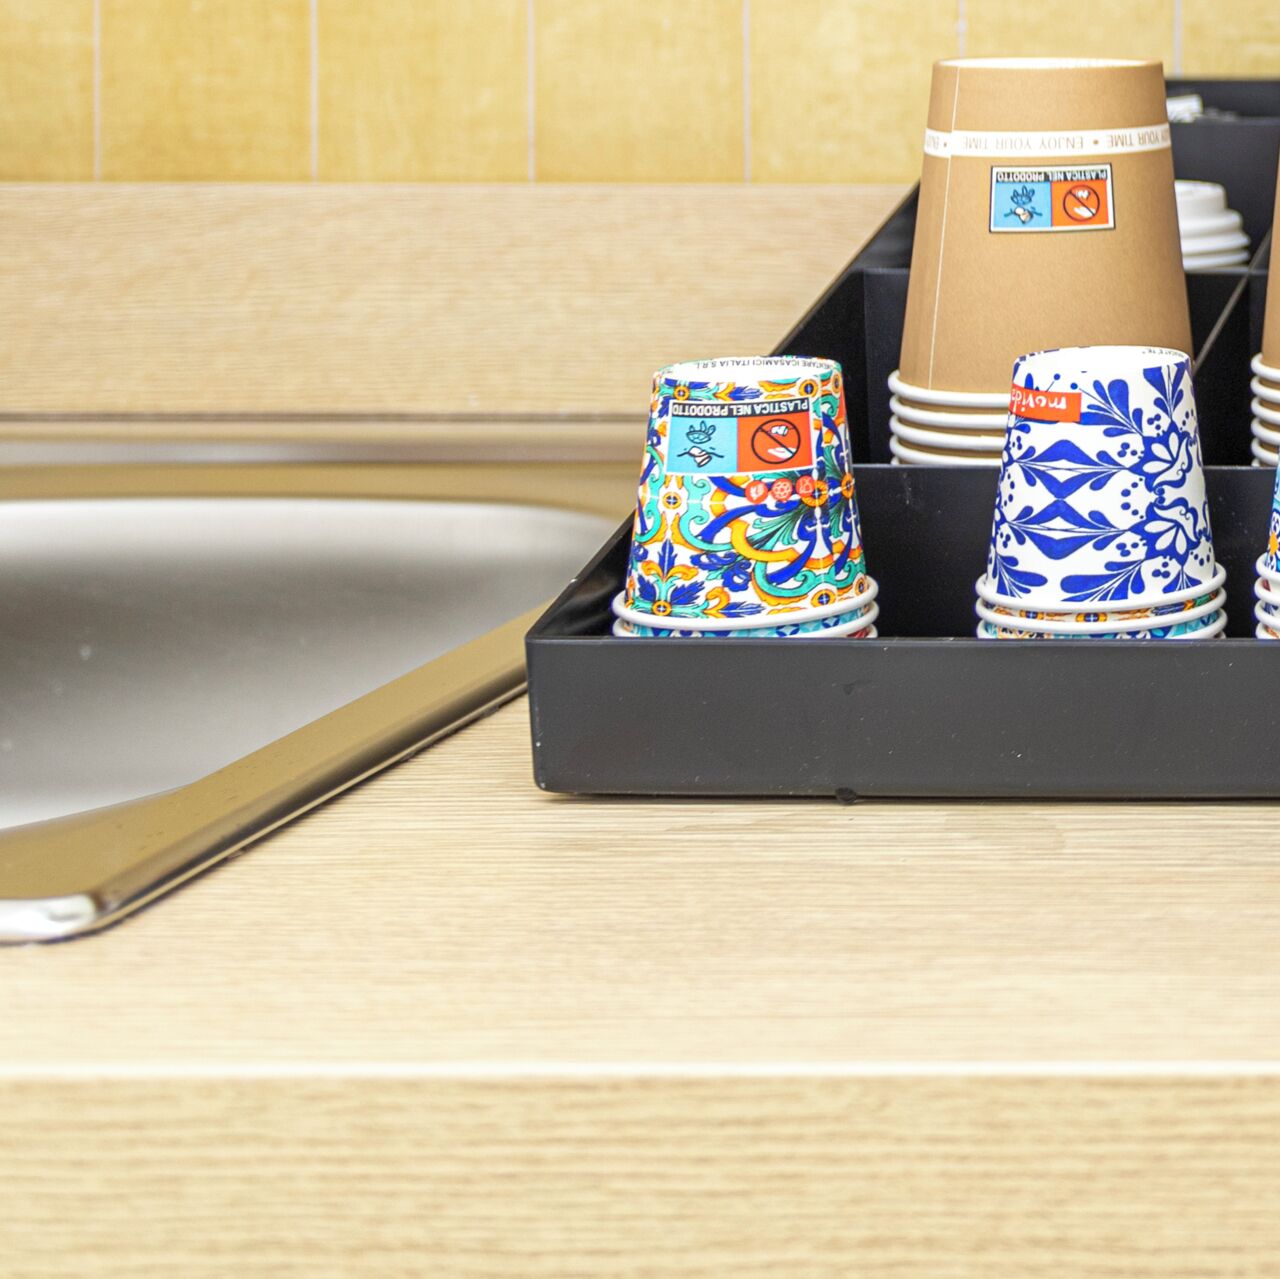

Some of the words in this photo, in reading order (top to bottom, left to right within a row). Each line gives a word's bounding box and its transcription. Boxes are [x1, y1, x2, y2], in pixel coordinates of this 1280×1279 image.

[963, 138, 989, 151] TIME
[995, 137, 1032, 150] YOUR
[1039, 136, 1084, 149] ENJOY
[1107, 132, 1133, 148] TIME
[997, 171, 1045, 183] PRODOTTO
[1067, 169, 1107, 181] PLASTICA
[672, 403, 729, 417] PRODOTTO
[730, 404, 751, 415] NEL
[753, 399, 808, 415] PLASTICA
